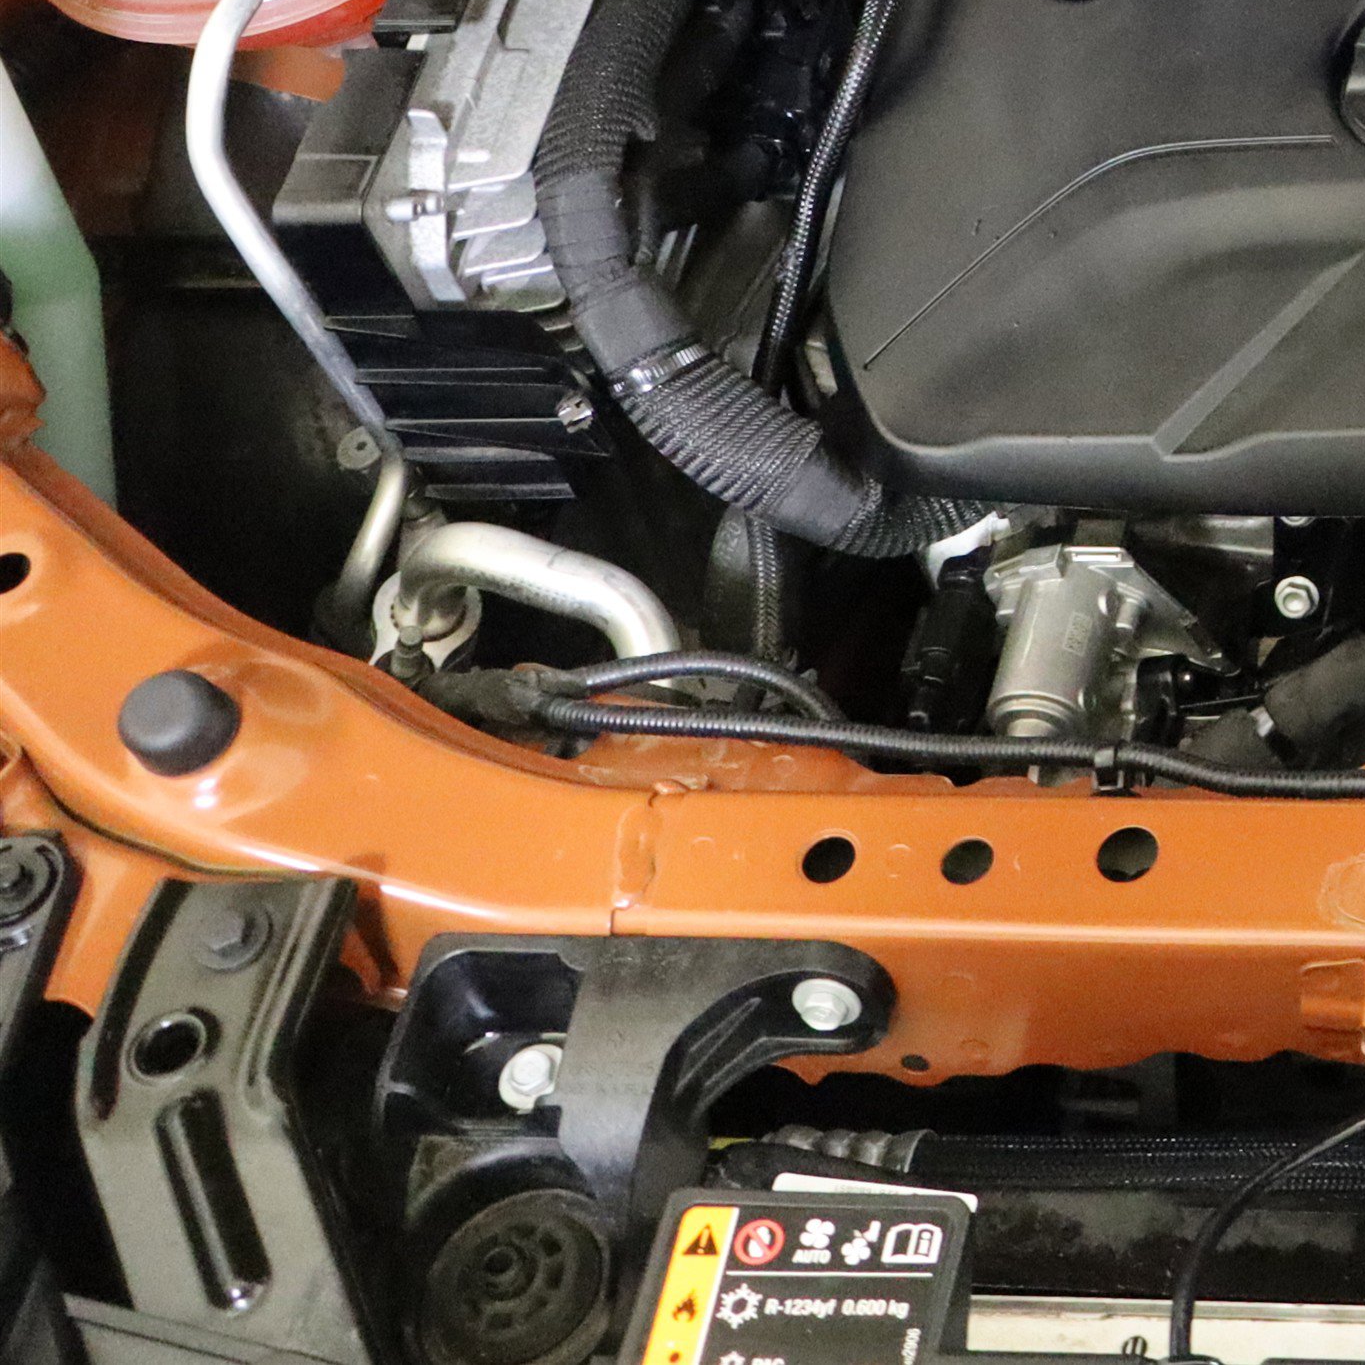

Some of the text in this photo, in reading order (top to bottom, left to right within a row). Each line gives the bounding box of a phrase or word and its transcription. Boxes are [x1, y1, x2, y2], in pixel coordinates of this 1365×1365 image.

[792, 1249, 832, 1264] AUTO
[764, 1298, 910, 1320] R-1234yf 0.600 kg
